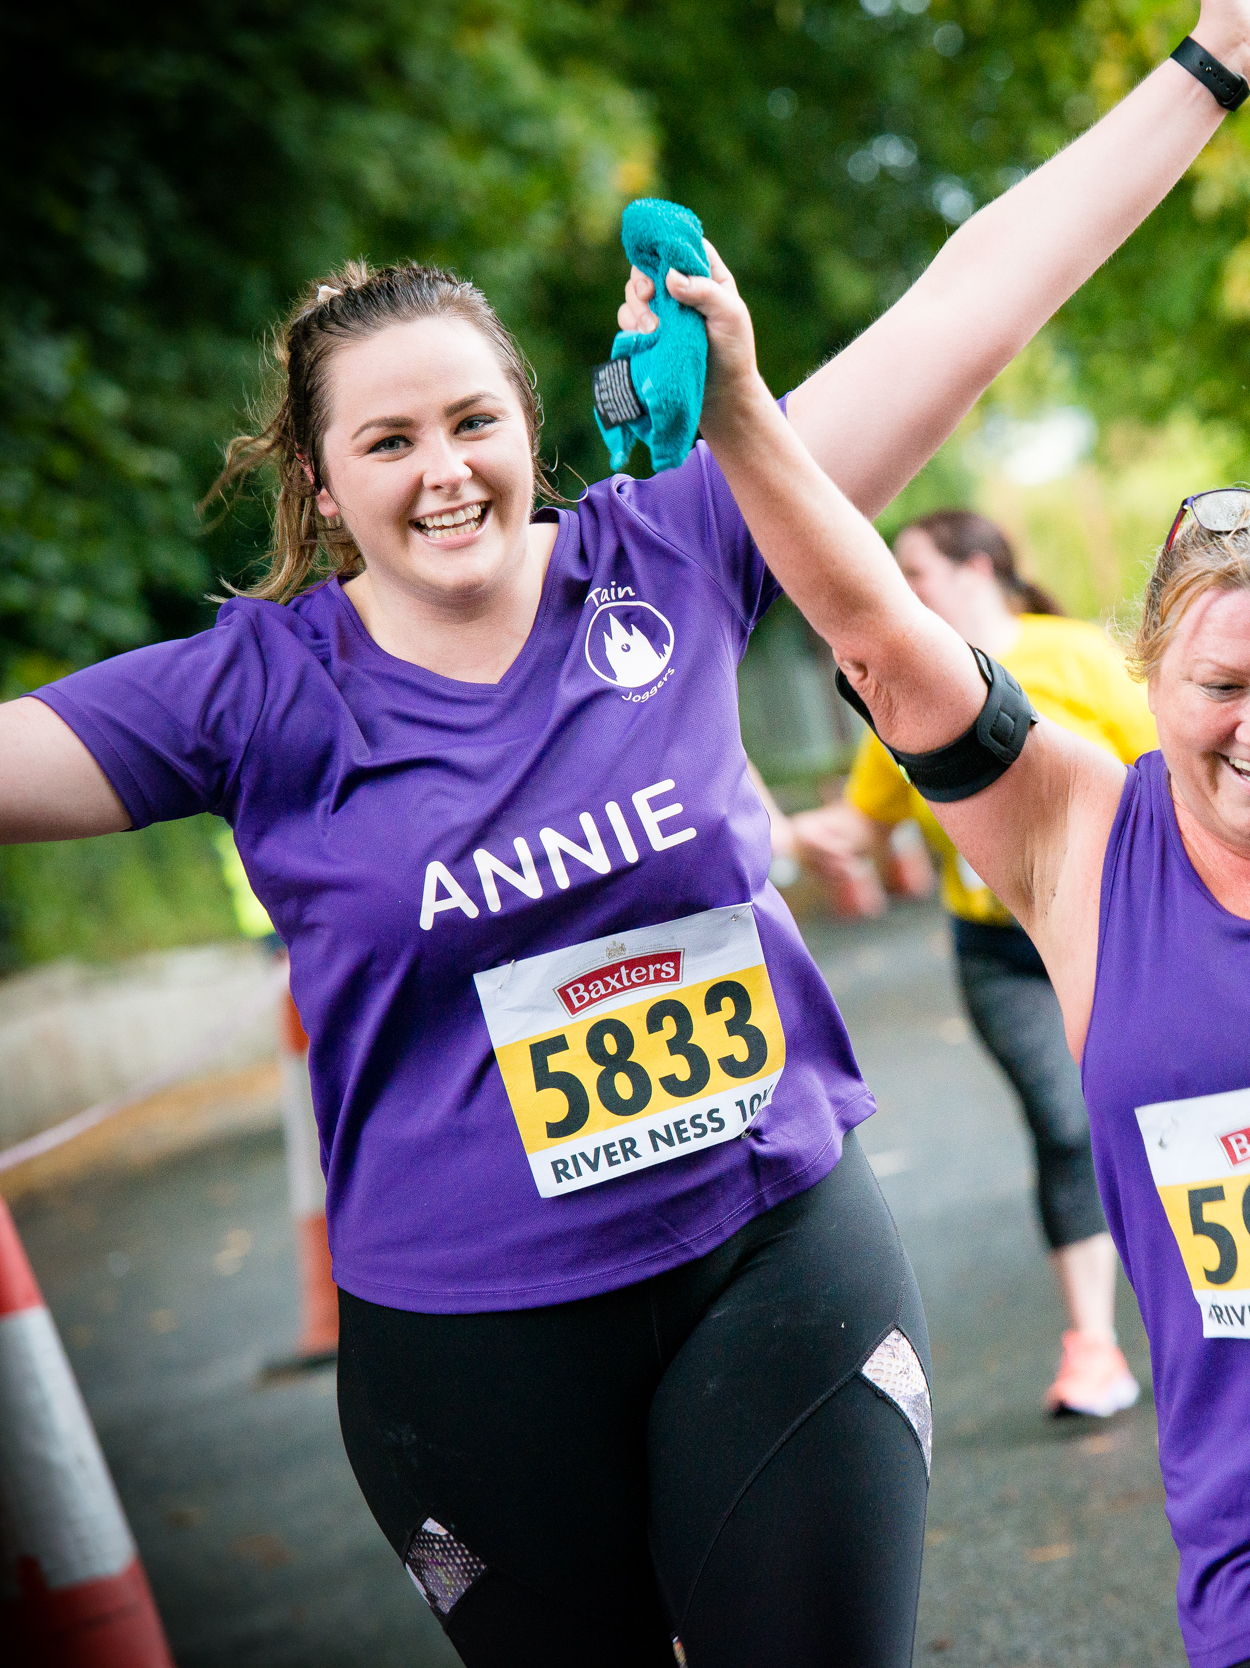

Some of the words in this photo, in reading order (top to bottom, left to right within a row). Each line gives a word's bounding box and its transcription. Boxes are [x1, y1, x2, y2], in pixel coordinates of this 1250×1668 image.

[585, 581, 636, 607] Tain
[621, 667, 675, 703] Joggers
[419, 779, 698, 931] ANNIE
[566, 961, 676, 1009] Baxters
[529, 980, 768, 1139] 5833
[550, 1137, 642, 1184] RIVER
[648, 1108, 725, 1152] NESS
